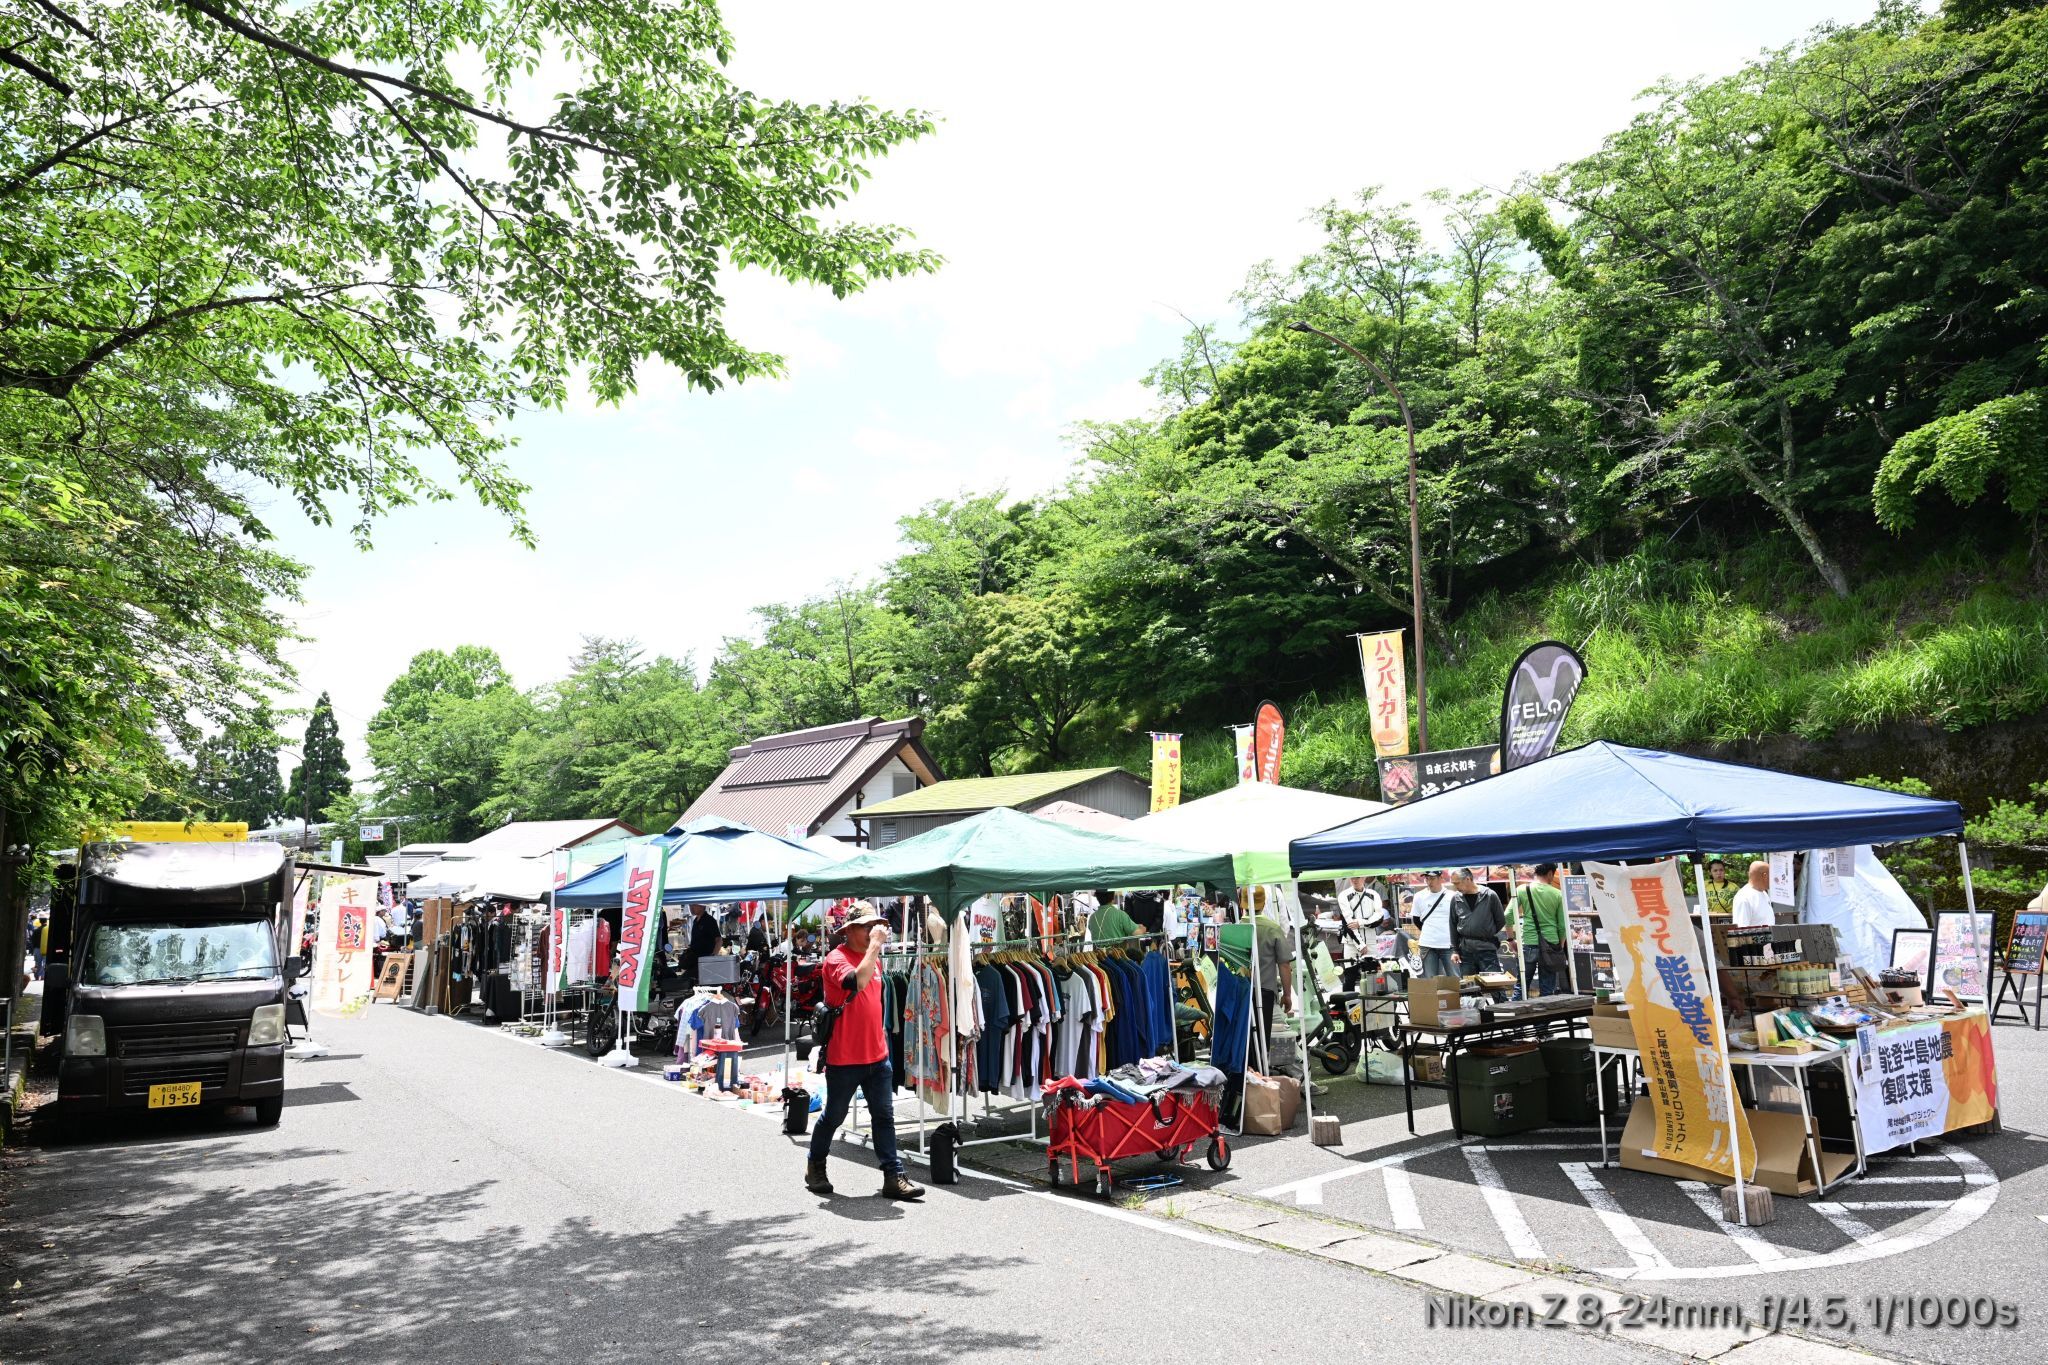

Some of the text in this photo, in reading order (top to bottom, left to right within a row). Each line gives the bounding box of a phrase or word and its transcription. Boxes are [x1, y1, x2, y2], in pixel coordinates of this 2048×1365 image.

[1374, 638, 1397, 729] ハンバーガー
[1511, 699, 1562, 720] FELO
[1168, 762, 1178, 808] ヤンニョ
[1425, 759, 1477, 775] 日本三大和牛
[1878, 1031, 1954, 1074] 能登半島地震
[161, 1091, 198, 1106] 19-56
[1654, 1027, 1687, 1153] 七尾地域復興プロジェクト
[1880, 1067, 1934, 1106] 復興支援
